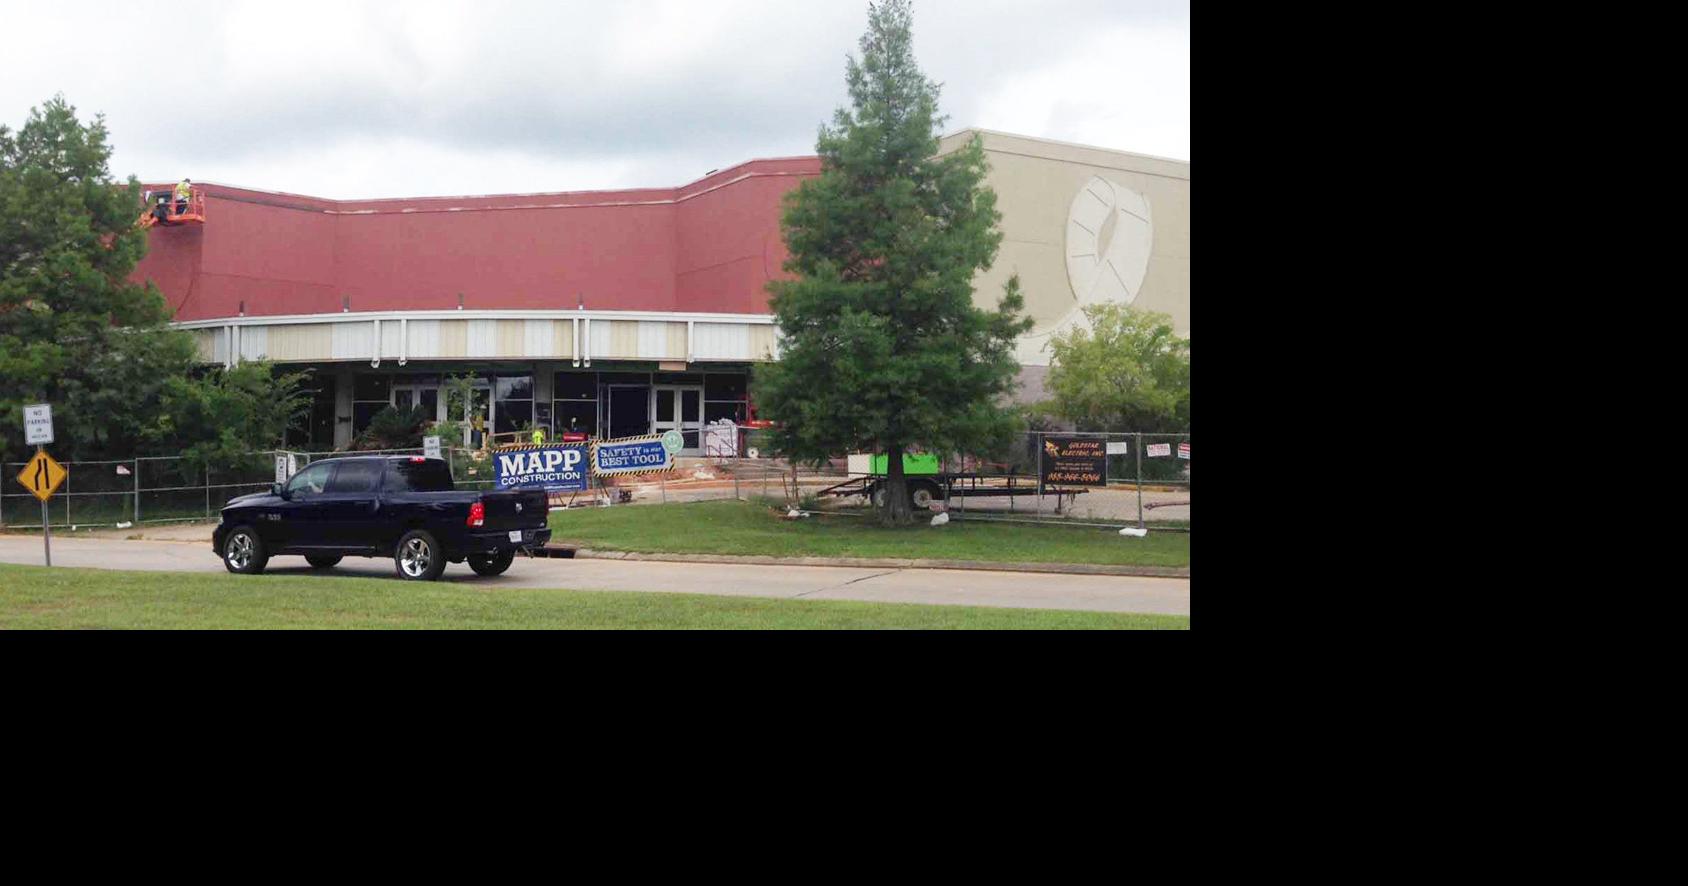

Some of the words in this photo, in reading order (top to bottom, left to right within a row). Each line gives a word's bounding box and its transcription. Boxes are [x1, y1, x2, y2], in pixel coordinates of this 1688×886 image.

[600, 447, 642, 458] SAFETY
[499, 450, 581, 477] MAPP
[601, 456, 630, 467] BEST
[631, 454, 663, 464] TOOL
[501, 472, 580, 486] CONSTRUCTION
